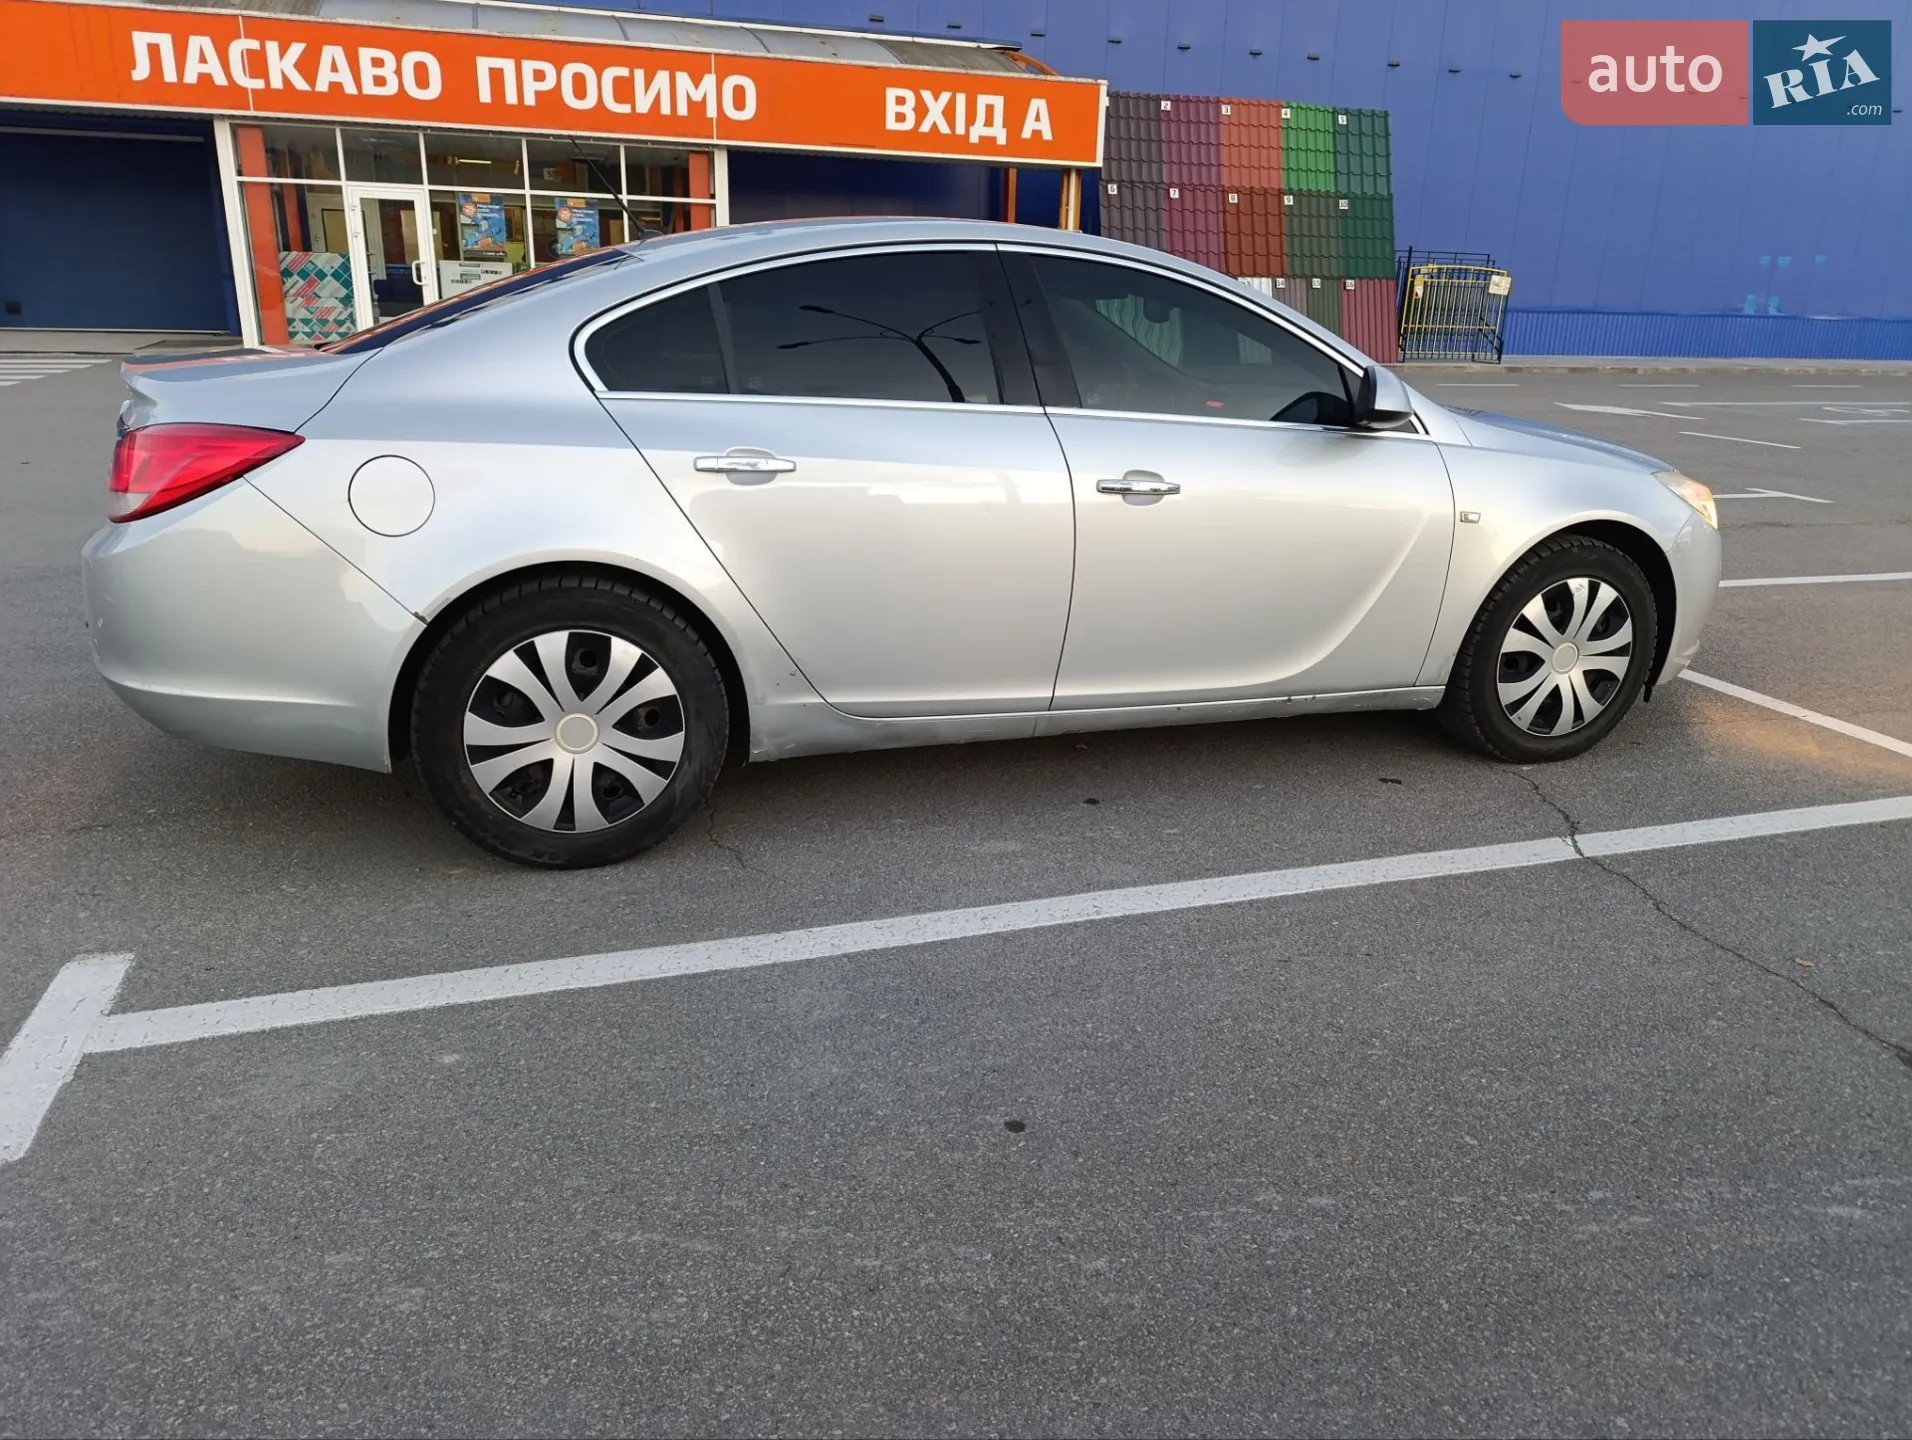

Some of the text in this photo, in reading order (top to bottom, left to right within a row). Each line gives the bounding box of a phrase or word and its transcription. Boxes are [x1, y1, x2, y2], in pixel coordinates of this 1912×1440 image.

[131, 31, 757, 121] ЛАСКАВО ПРОСИМО
[885, 87, 1053, 145] ВХІД А
